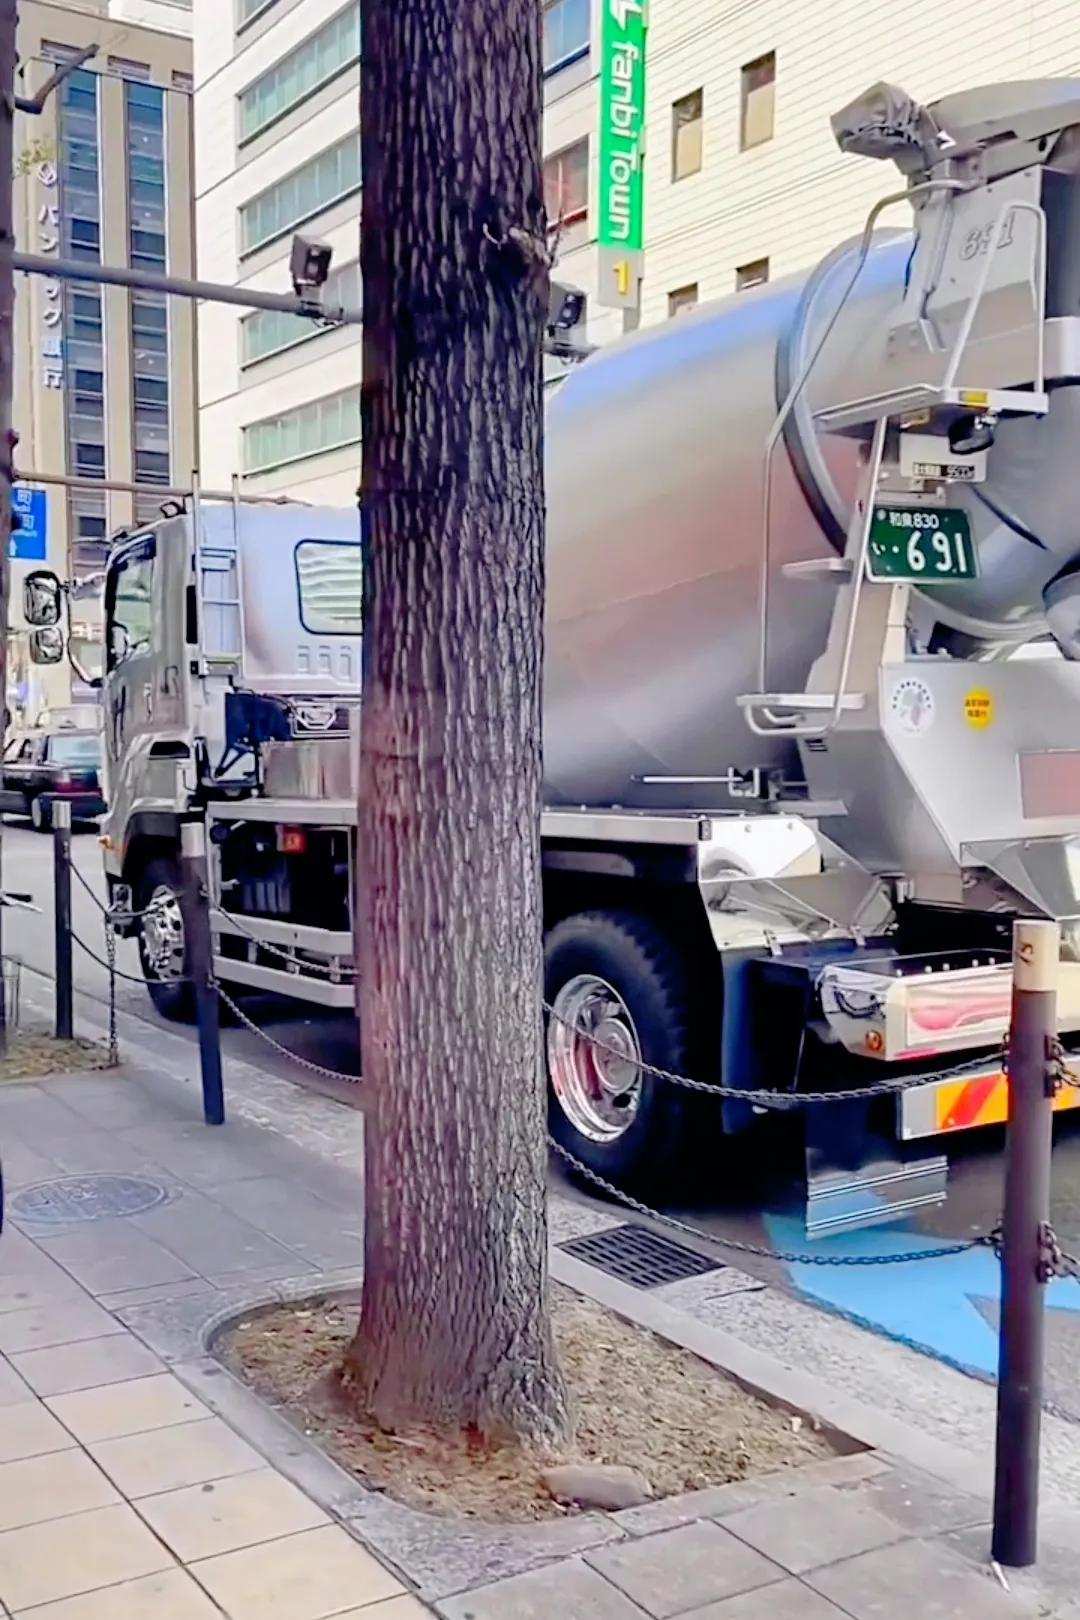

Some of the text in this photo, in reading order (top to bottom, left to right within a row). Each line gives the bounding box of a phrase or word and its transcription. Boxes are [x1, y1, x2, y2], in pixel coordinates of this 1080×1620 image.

[609, 41, 640, 241] fanbi Town
[613, 260, 629, 296] 1
